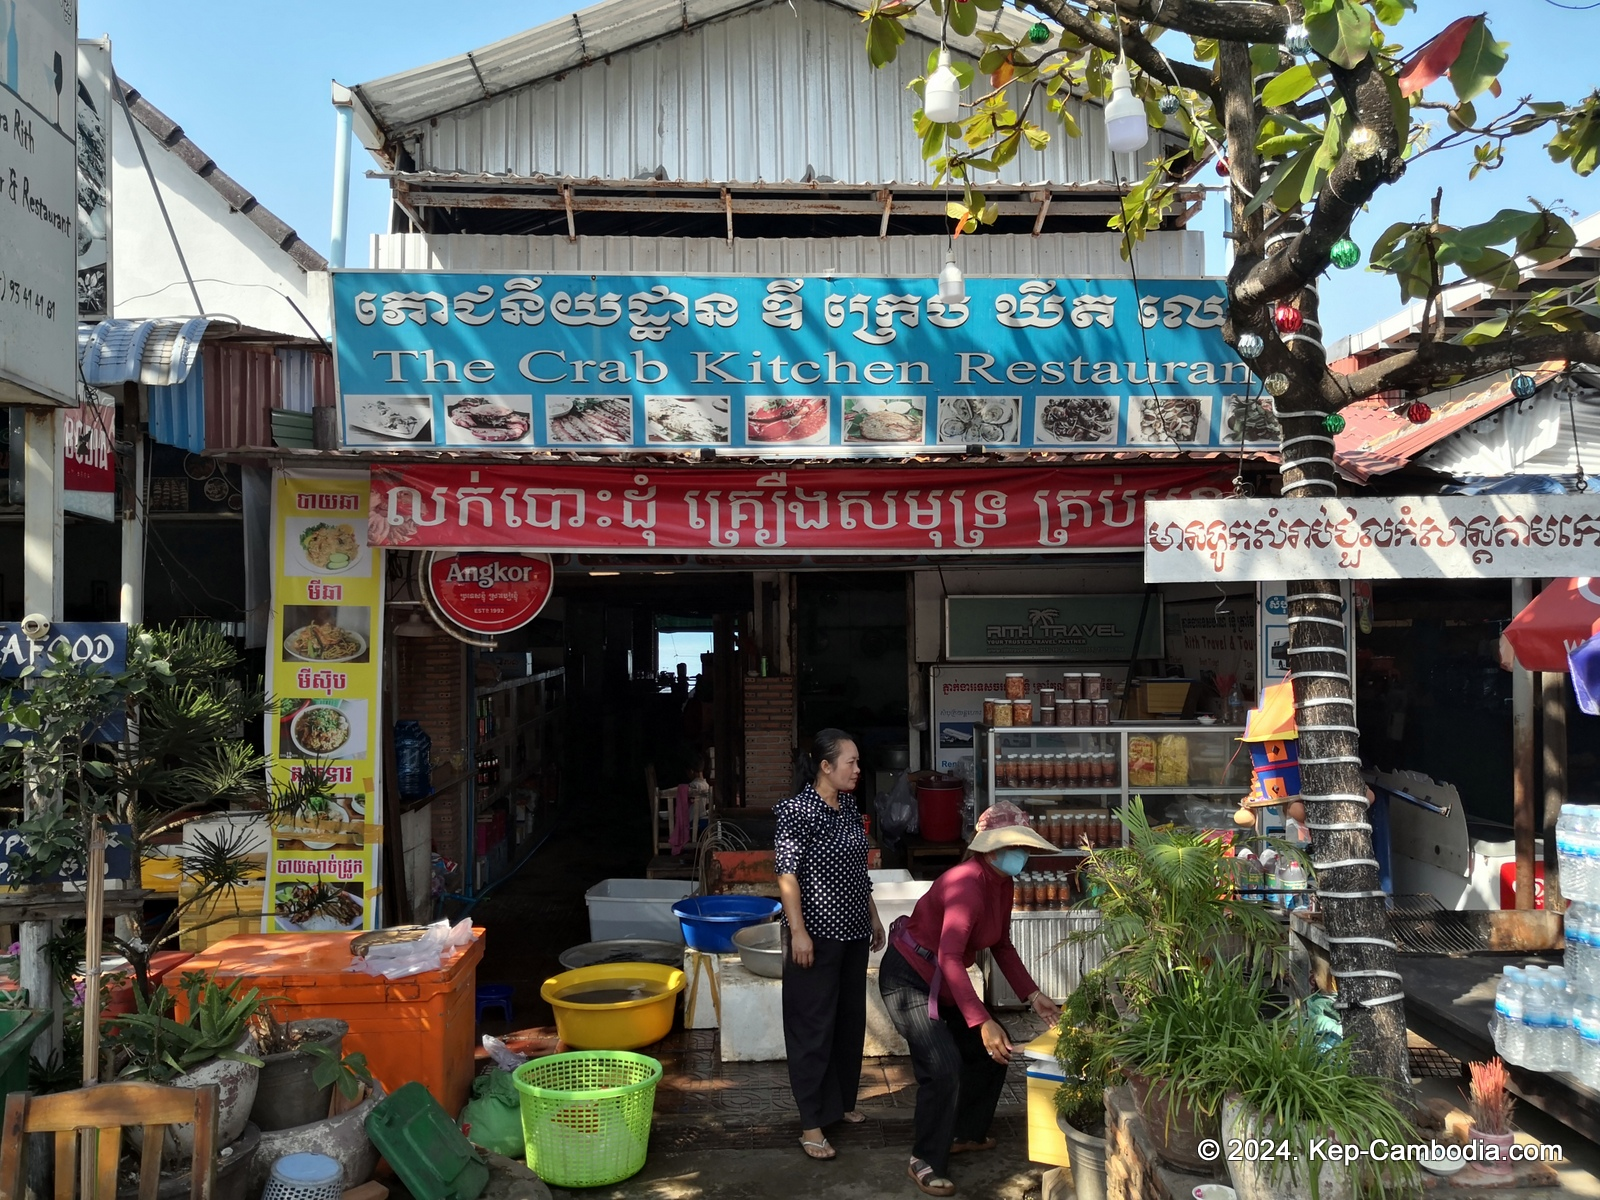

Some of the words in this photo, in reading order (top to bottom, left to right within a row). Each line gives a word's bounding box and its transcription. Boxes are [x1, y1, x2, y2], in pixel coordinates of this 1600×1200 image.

[14, 109, 34, 153] Rith
[9, 167, 18, 200] &
[23, 177, 71, 238] Restaurant
[9, 280, 20, 298] 93
[23, 287, 32, 304] 41
[35, 293, 44, 311] 41
[47, 301, 55, 319] 81
[354, 277, 740, 341] ភោជនីយដ្ឋាន
[1138, 294, 1228, 330] ឈេ
[373, 350, 495, 384] The
[518, 350, 668, 384] Crab
[690, 350, 934, 385] Kitchen
[954, 352, 1256, 385] Restauran
[297, 493, 359, 510] បាយឆា
[308, 579, 342, 600] មីឆា
[446, 561, 532, 588] Angkor
[986, 625, 1033, 638] RITH
[1040, 625, 1124, 638] TRAVEL
[1185, 636, 1200, 649] Rith
[1202, 635, 1226, 650] Travel
